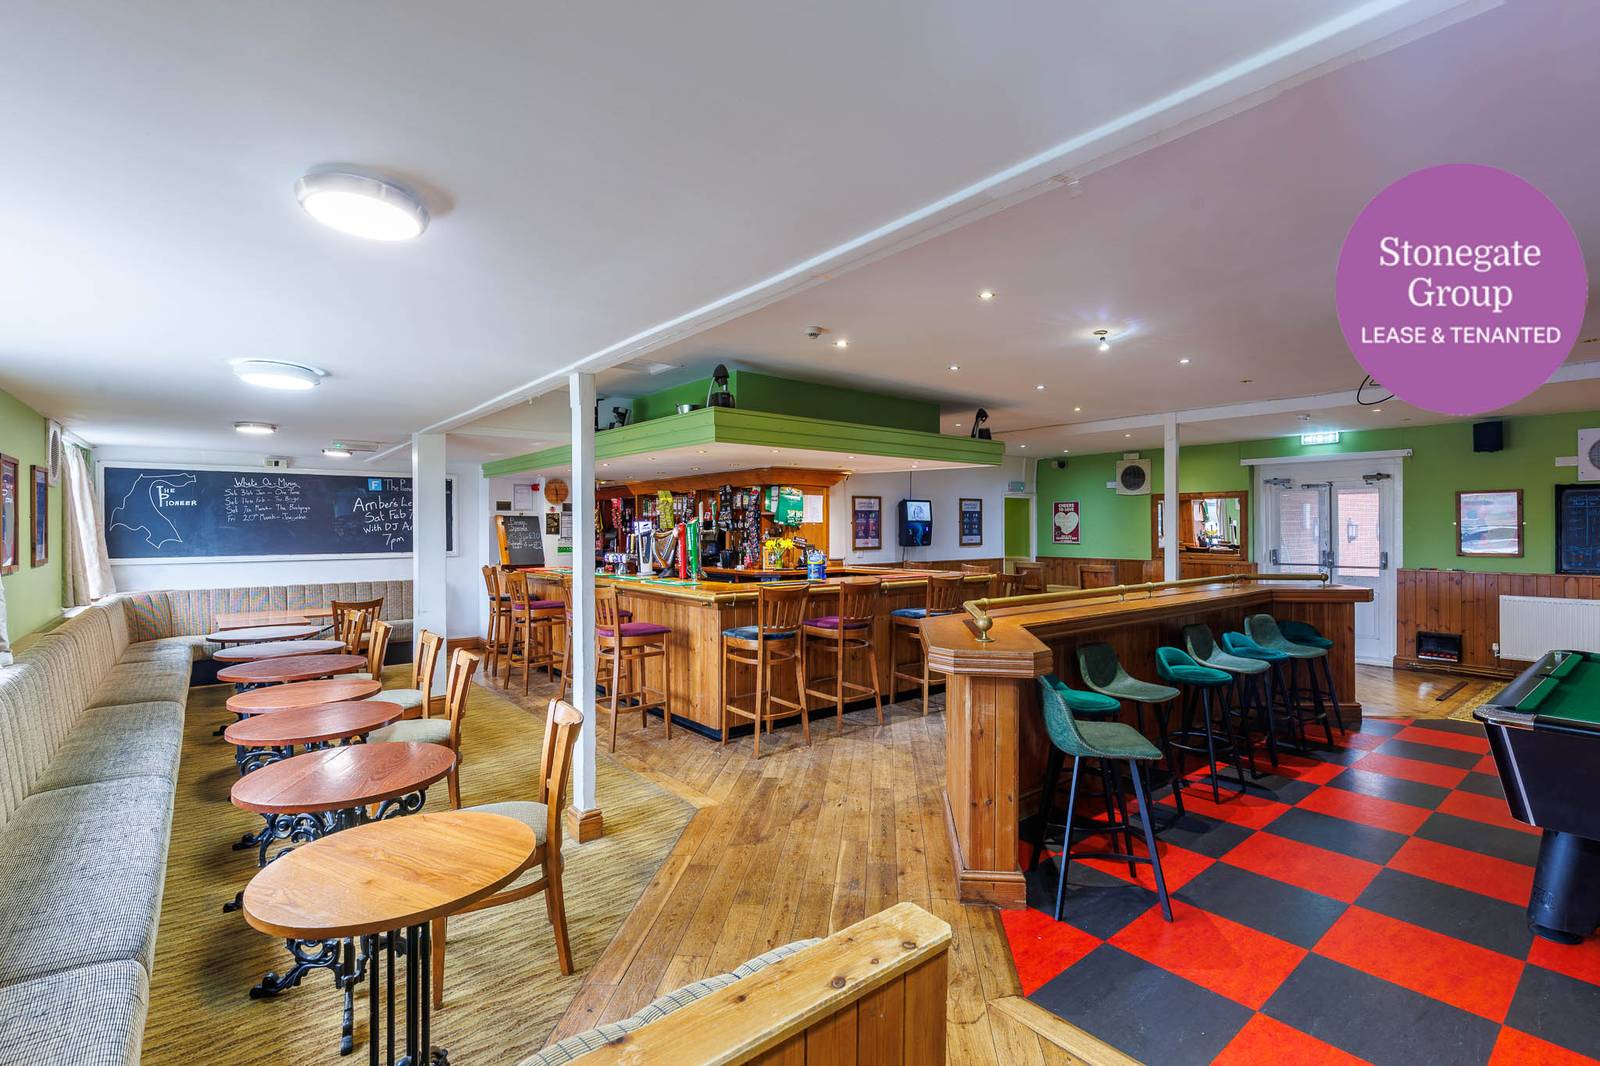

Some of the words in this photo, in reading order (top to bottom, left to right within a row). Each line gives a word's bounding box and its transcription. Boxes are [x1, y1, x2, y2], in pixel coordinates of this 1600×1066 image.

[384, 479, 399, 491] The
[159, 493, 198, 508] PIONEER
[352, 496, 399, 512] Amber's
[365, 511, 385, 523] Sat
[389, 508, 406, 520] Feb
[385, 522, 399, 531] DJ
[383, 533, 405, 550] 7pm
